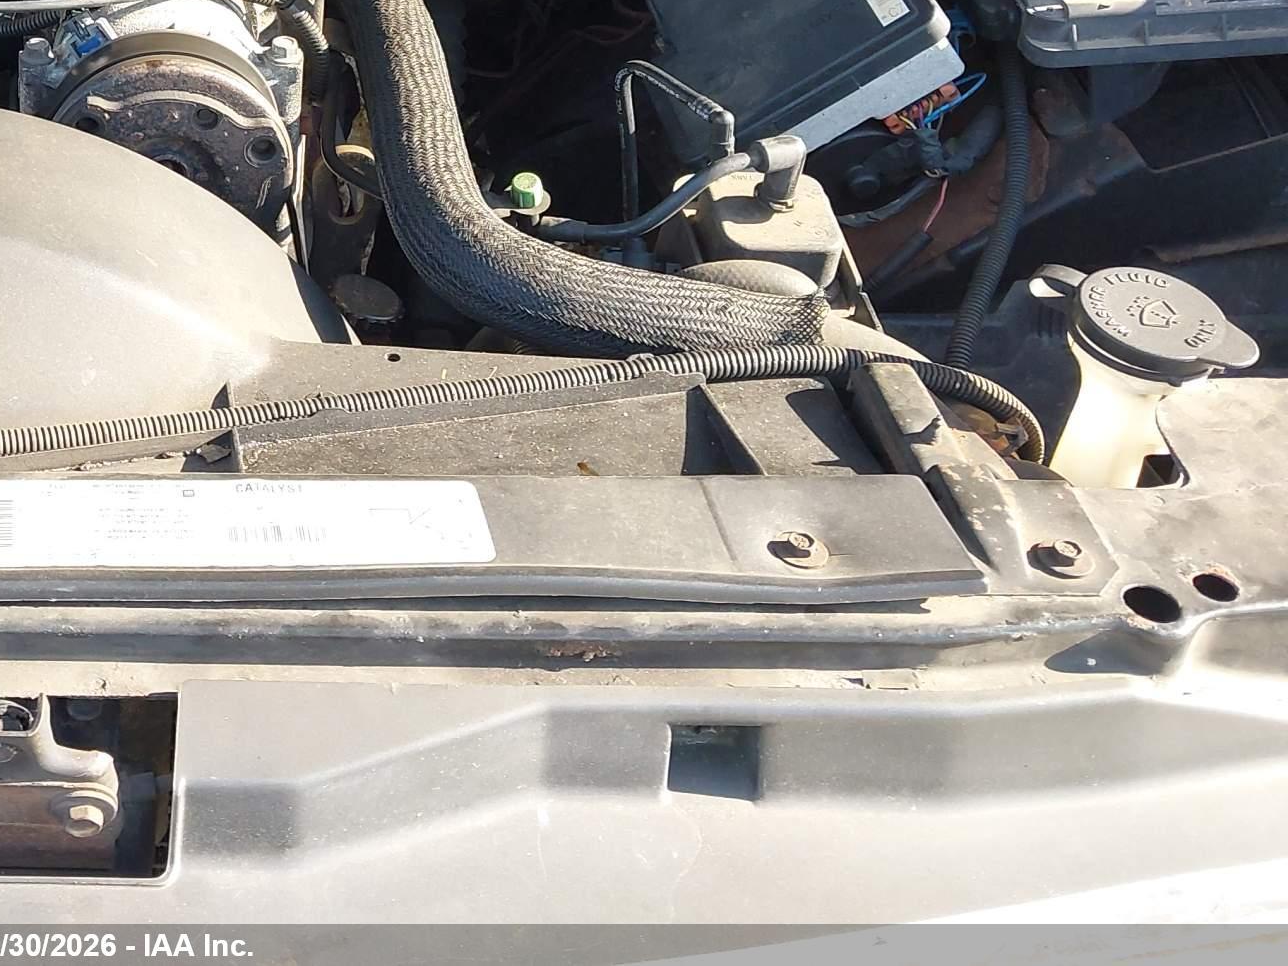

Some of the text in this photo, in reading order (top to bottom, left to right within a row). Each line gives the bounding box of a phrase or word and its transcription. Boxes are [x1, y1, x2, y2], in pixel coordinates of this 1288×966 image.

[1103, 271, 1170, 289] FLUID
[1183, 318, 1218, 349] ONLY
[234, 482, 304, 494] CATALYST
